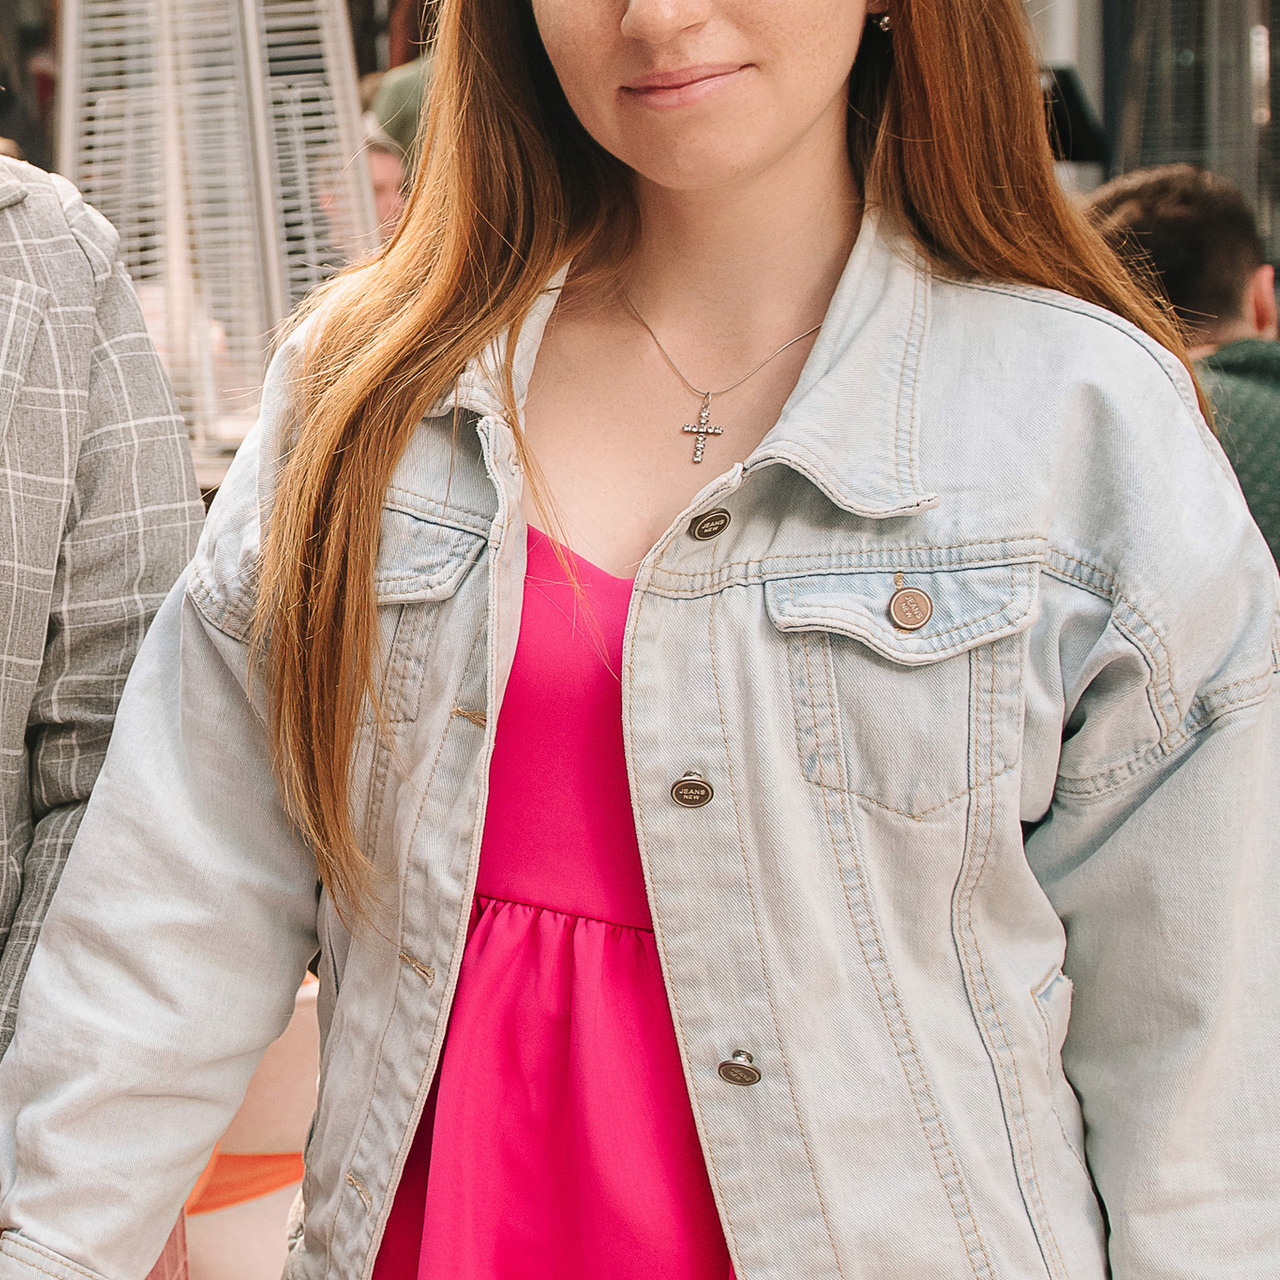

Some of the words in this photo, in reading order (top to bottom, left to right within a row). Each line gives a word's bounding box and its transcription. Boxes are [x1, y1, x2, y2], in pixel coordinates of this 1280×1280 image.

[701, 519, 726, 530] JEANS
[900, 602, 914, 619] NEW
[904, 595, 924, 620] JEANS
[678, 788, 706, 796] JEANS
